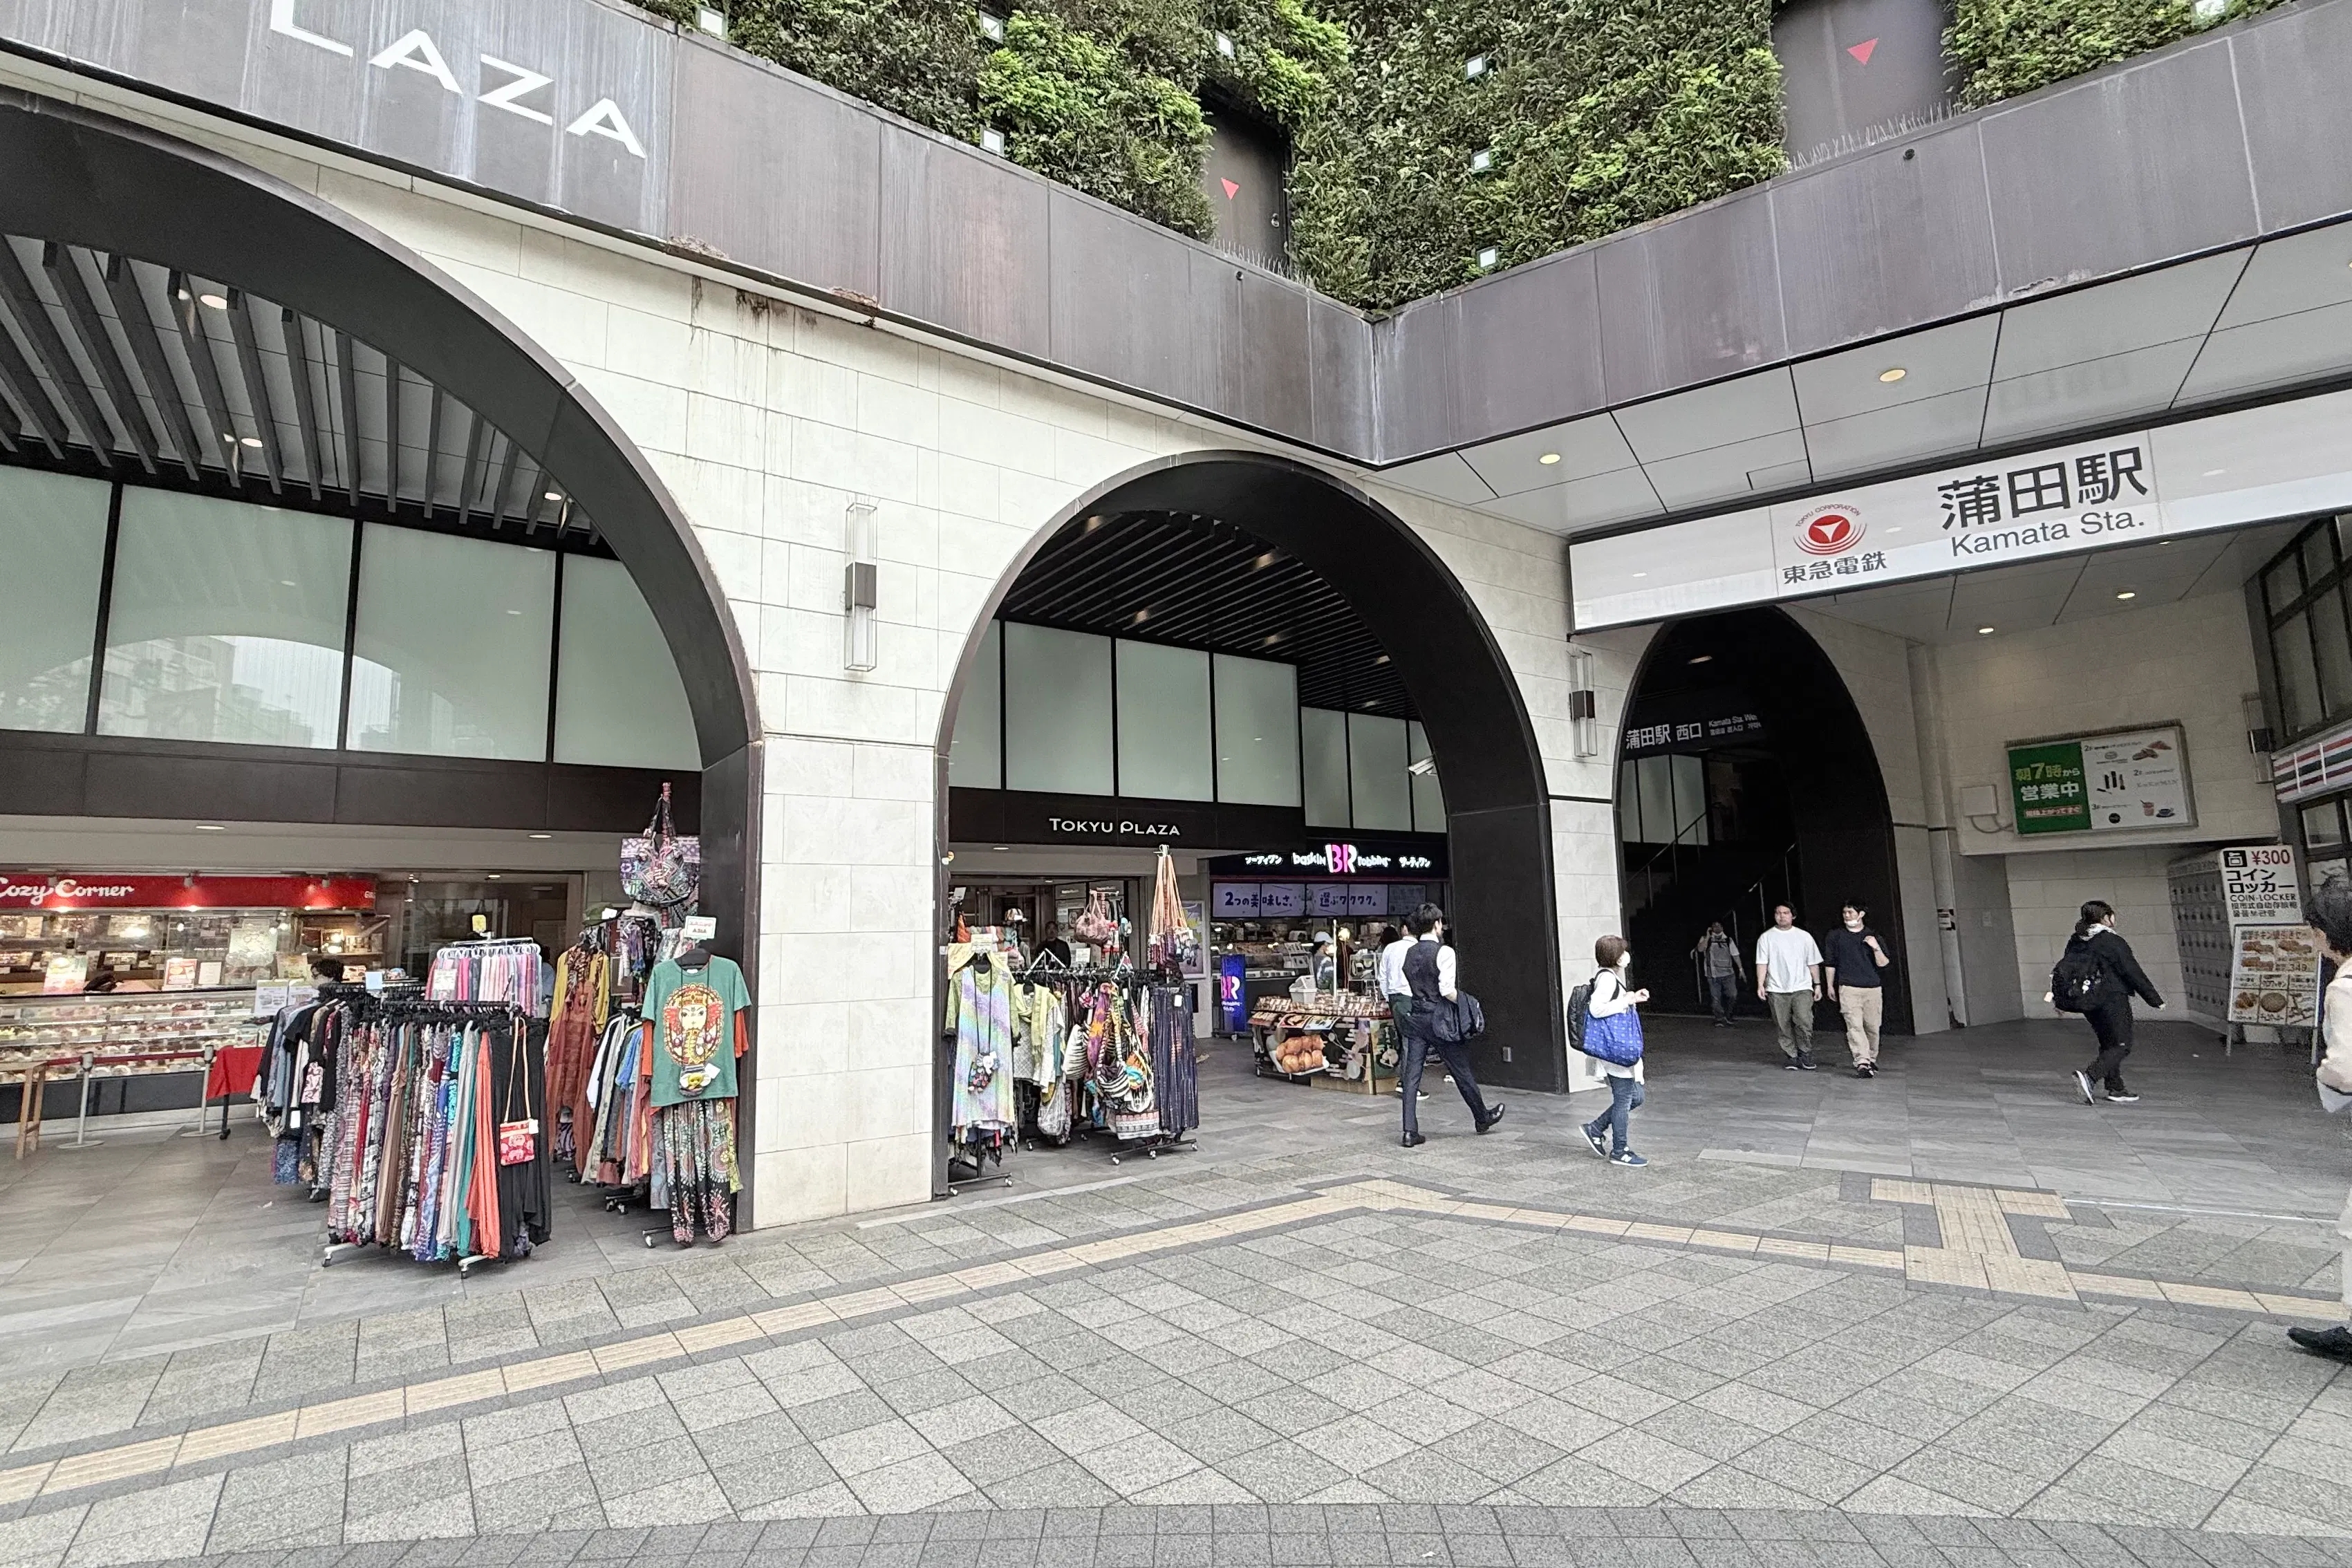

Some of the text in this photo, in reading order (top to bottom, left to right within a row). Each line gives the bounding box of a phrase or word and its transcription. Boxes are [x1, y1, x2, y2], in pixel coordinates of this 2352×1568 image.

[1937, 447, 2149, 531] 蒲田駅
[1795, 503, 1862, 528] TOKYU CORPORATION
[1952, 512, 2145, 557] Kamata Sta.
[1782, 551, 1887, 584] 東急電鉄
[1626, 722, 1703, 749] 蒲田駅 西口
[2015, 763, 2081, 782] 朝7時から
[2021, 781, 2080, 801] 営業中
[1049, 818, 1181, 836] TOKYU PLAZA
[1325, 843, 1359, 874] BR
[2251, 849, 2290, 865] ¥300
[2226, 868, 2276, 881] コイン
[55, 879, 135, 897] Corner
[2229, 881, 2295, 893] ロッカー
[2230, 893, 2297, 902] COIN-LOCKER
